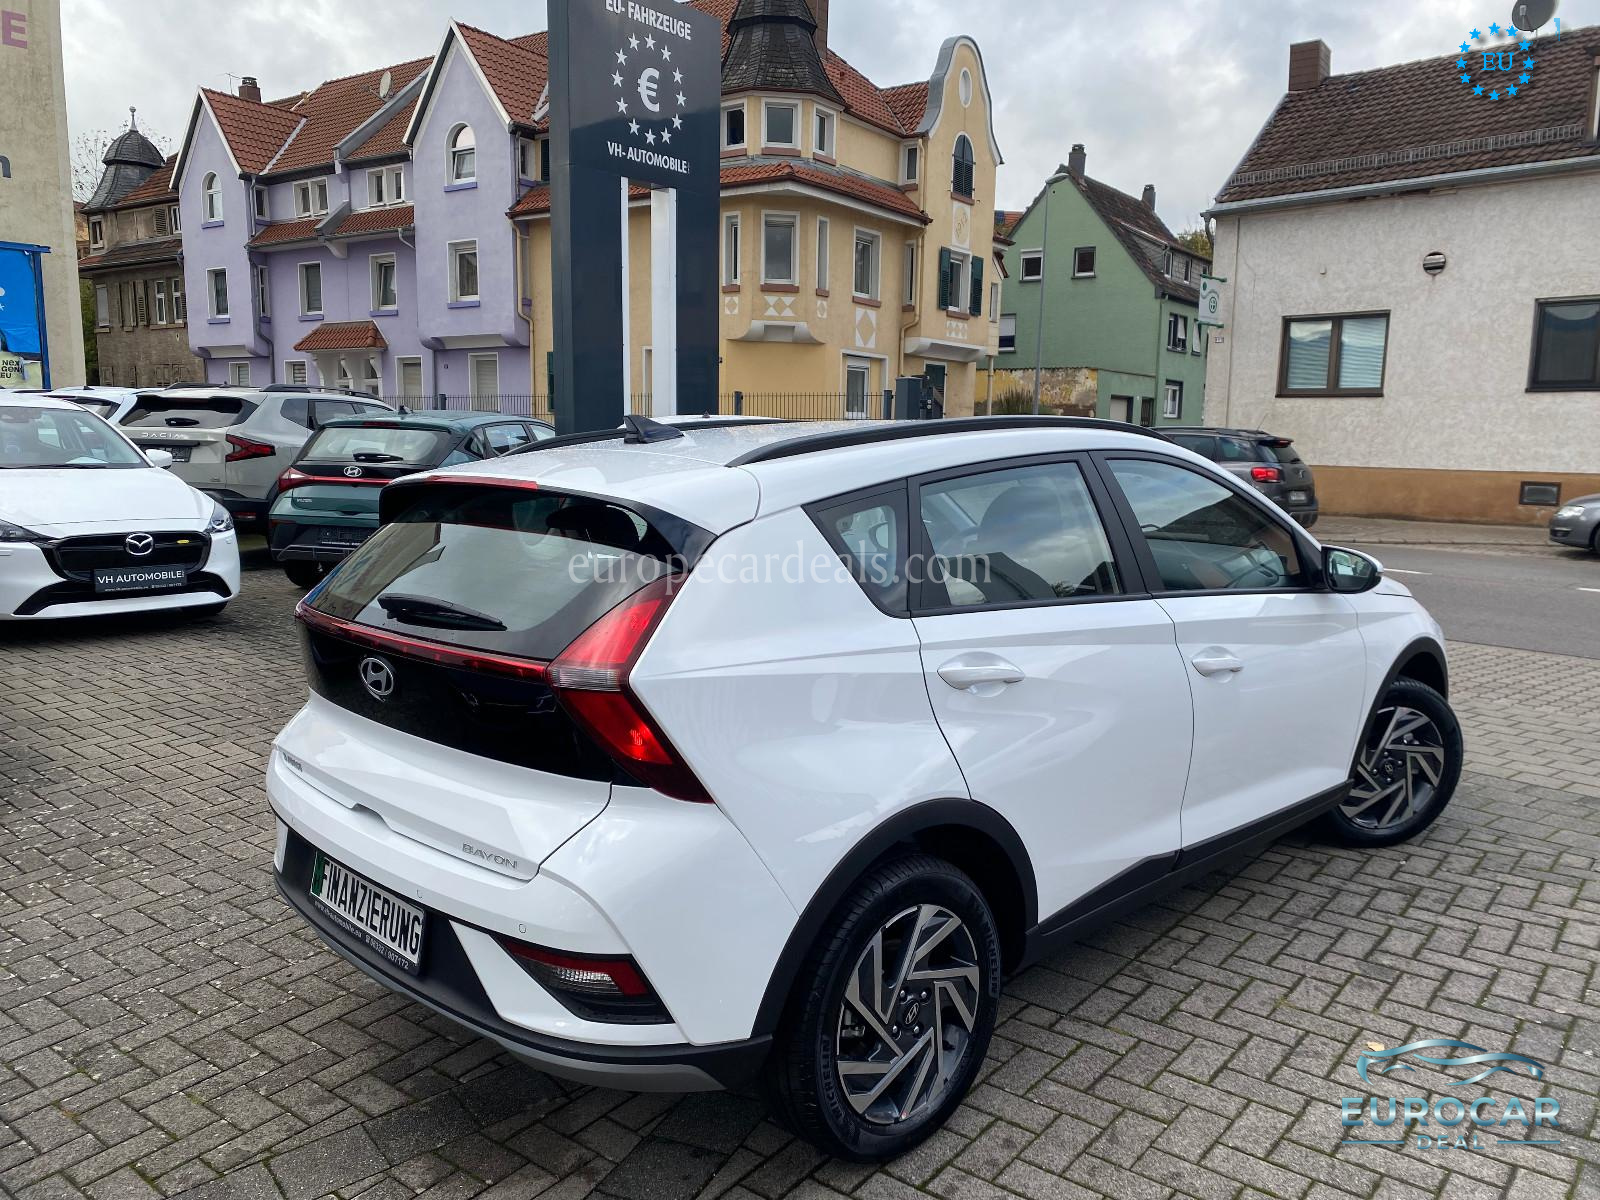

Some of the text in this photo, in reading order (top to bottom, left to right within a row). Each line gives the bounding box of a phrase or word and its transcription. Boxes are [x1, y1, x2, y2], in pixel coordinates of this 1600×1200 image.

[628, 2, 691, 40] FAHRZEUGE
[627, 147, 688, 174] AUTOMOBILE
[97, 575, 114, 584] VH
[116, 570, 182, 583] AUTOMOBILE
[461, 843, 519, 870] BAYON
[320, 860, 422, 955] FINANZIERUNG
